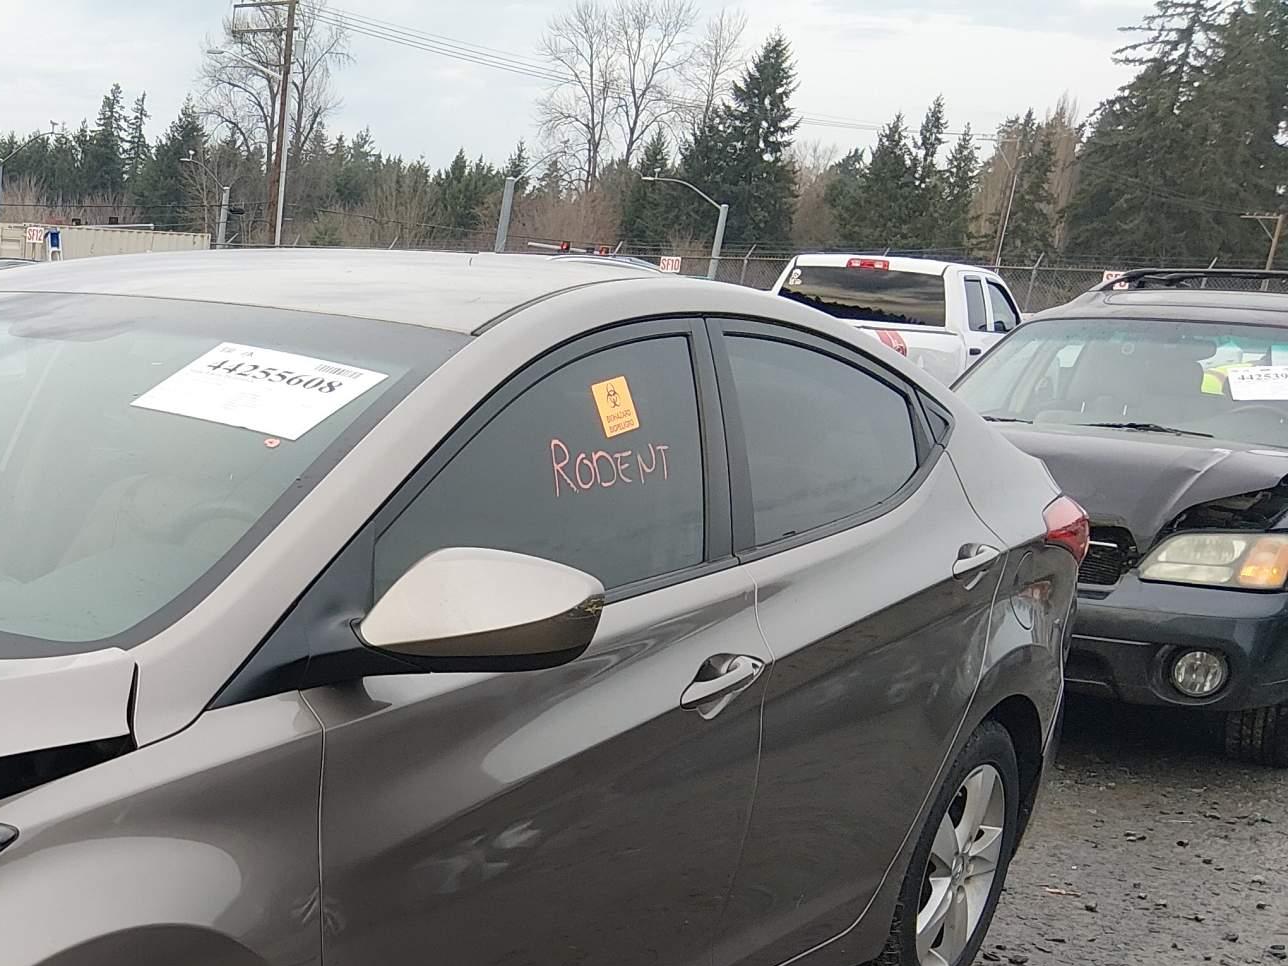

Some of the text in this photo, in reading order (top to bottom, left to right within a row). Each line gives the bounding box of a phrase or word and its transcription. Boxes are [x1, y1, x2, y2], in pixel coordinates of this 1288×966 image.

[27, 229, 43, 241] SF12
[661, 258, 680, 271] SF10
[207, 359, 344, 394] 44255608
[551, 439, 669, 497] RODENT
